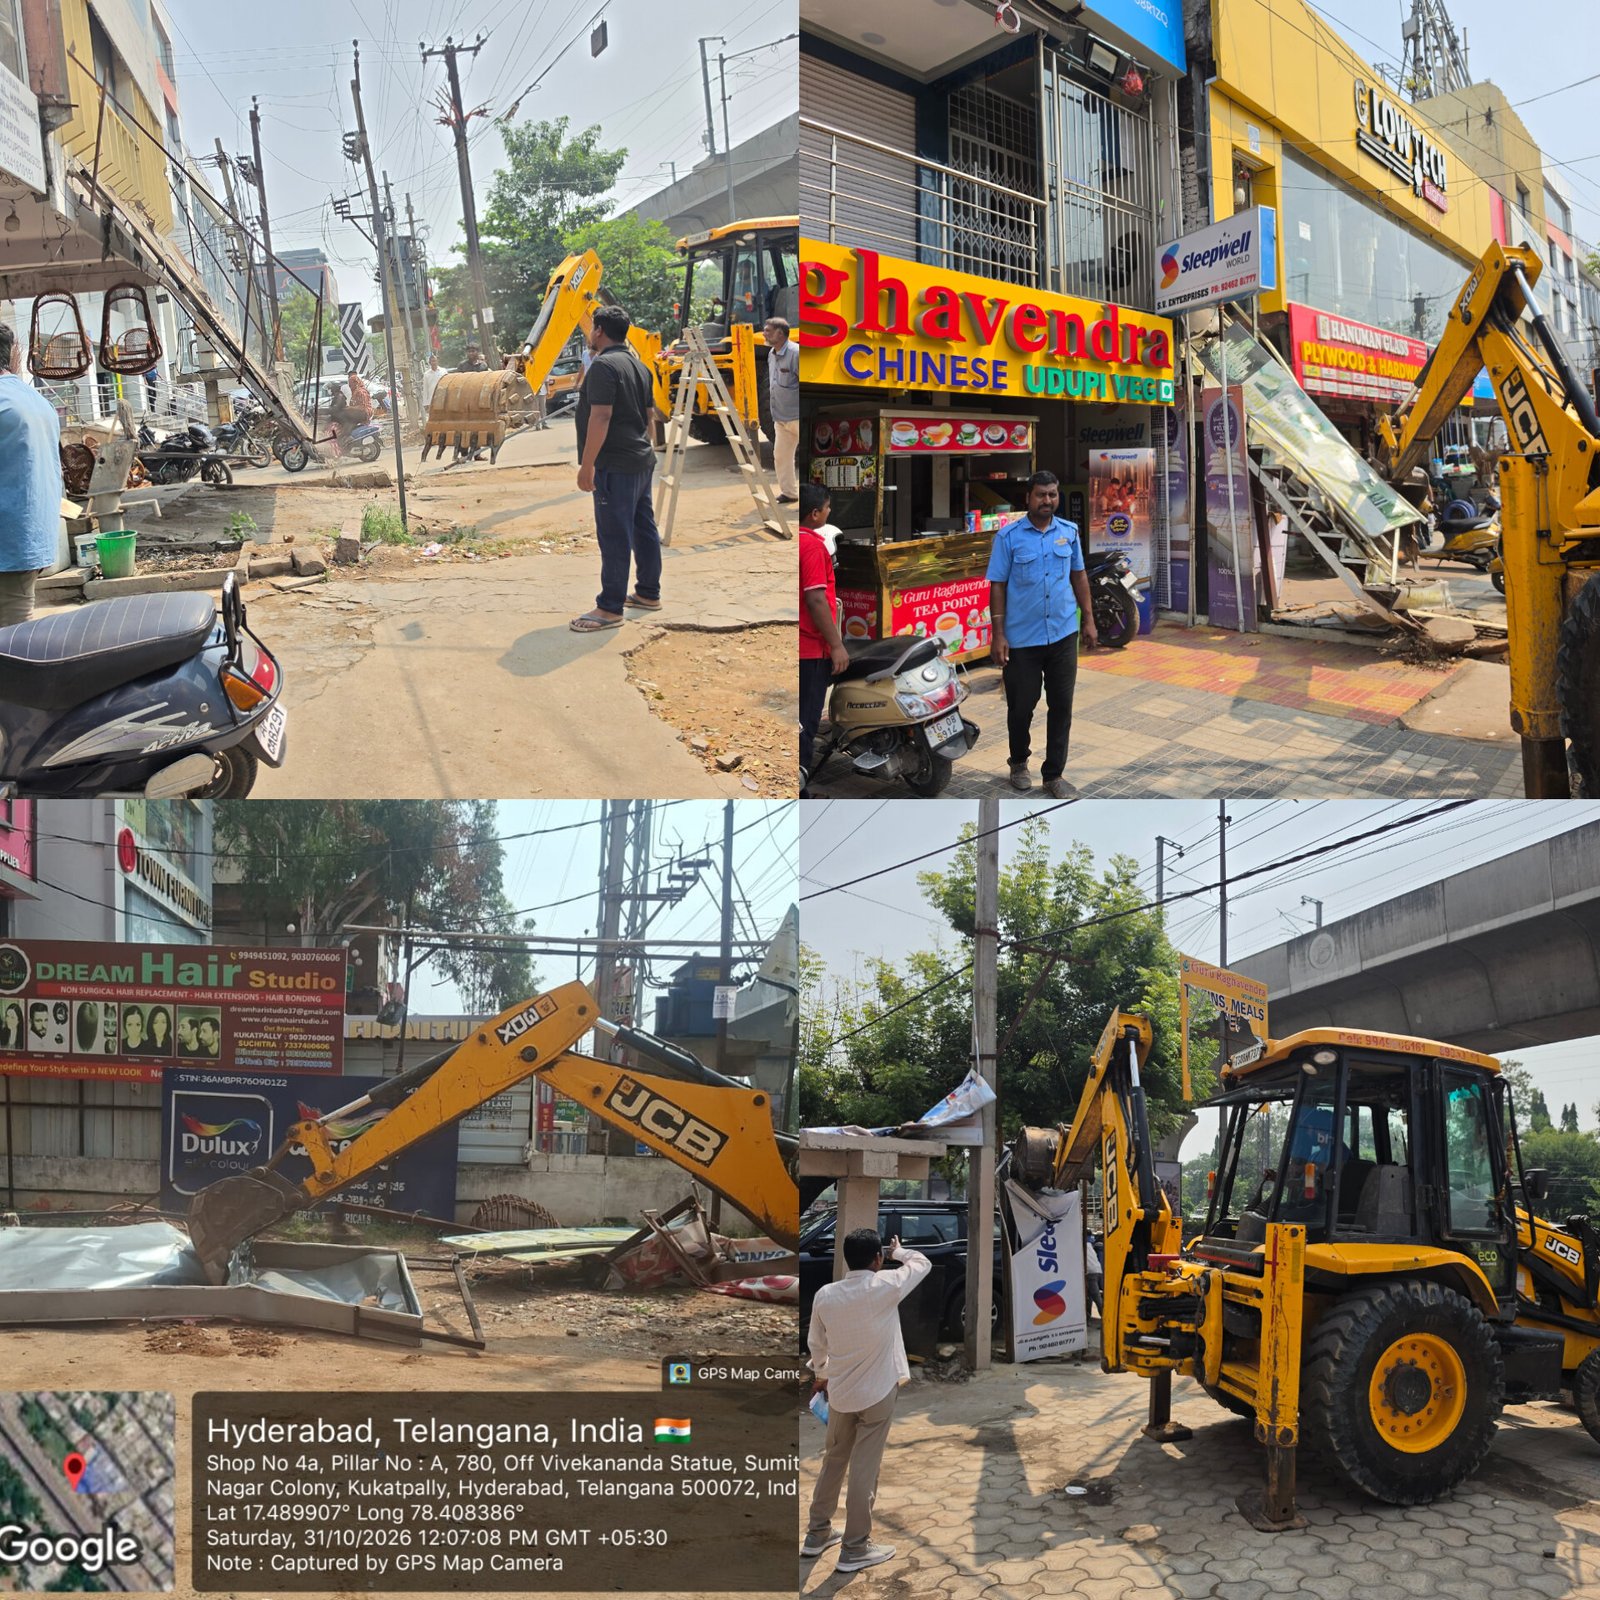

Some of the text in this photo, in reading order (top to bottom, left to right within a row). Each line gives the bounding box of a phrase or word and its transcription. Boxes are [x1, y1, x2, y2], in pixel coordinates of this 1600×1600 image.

[1181, 231, 1251, 273] Sleepwell
[1226, 254, 1250, 268] WORLD
[1169, 288, 1209, 306] ENTERPRISES
[800, 248, 1172, 370] ghavendra
[1303, 341, 1367, 372] PLYWOOD
[1367, 356, 1378, 374] &
[843, 343, 1009, 390] CHINESE
[1023, 364, 1107, 399] UDUPI
[904, 589, 930, 604] Guru
[913, 595, 981, 617] TEA POINT
[140, 722, 213, 754] Activa
[36, 952, 336, 990] DREAM Hair Studio
[1191, 961, 1215, 978] Guru
[60, 986, 78, 994] NON
[79, 986, 115, 996] SURGICAL
[116, 988, 135, 996] HAIR
[136, 988, 188, 999] REPLACEMENT
[214, 992, 260, 1001] EXTENSIONS
[285, 995, 322, 1003] BONDING
[1231, 999, 1264, 1021] MEALS
[233, 1032, 282, 1040] KUKATPALLY
[238, 1040, 277, 1048] SUCHITRA
[30, 1064, 49, 1072] Your
[50, 1064, 69, 1073] Style
[98, 1067, 117, 1075] NEW
[120, 1068, 142, 1076] LOOK
[610, 1087, 722, 1163] JCB
[182, 1132, 250, 1156] Dulux
[1478, 1251, 1498, 1262] eco
[1546, 1239, 1580, 1264] JCB
